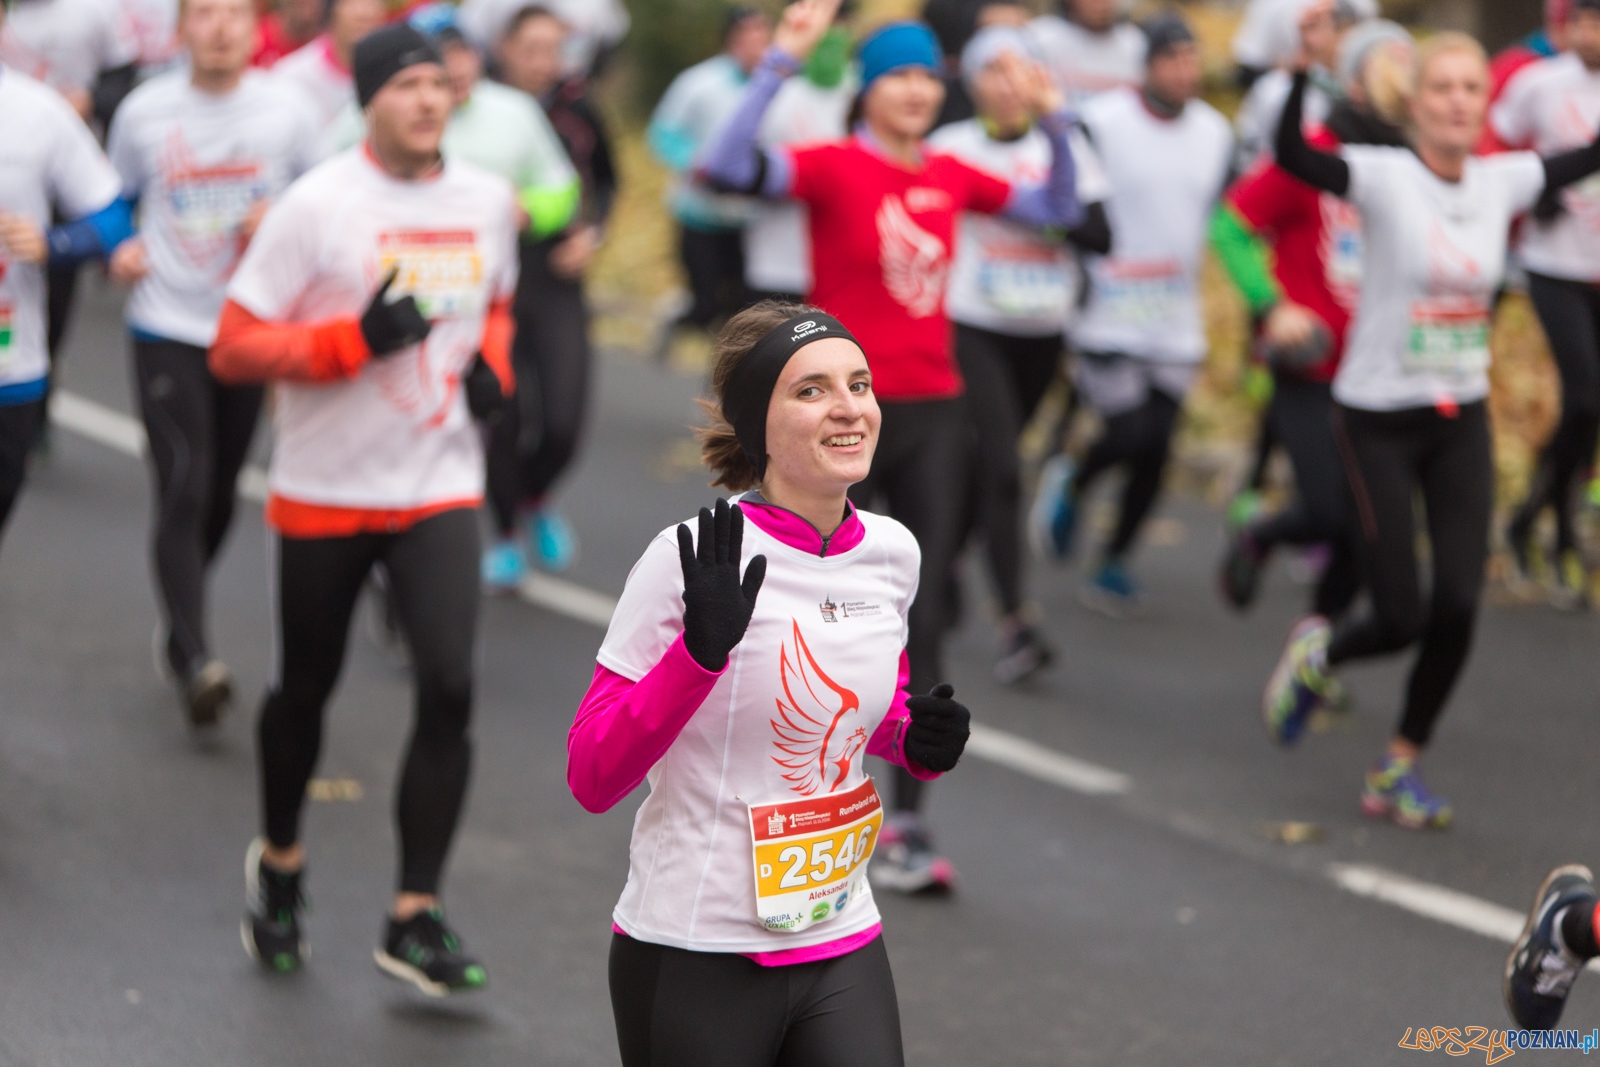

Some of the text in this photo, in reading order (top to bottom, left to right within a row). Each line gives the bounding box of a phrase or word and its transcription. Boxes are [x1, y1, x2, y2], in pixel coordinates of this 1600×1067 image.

[791, 325, 828, 342] Kalenji
[840, 602, 849, 618] 1
[839, 793, 876, 816] RunPoland.org
[789, 813, 797, 828] 1
[760, 824, 872, 889] D 2546
[765, 913, 791, 924] GRUPA
